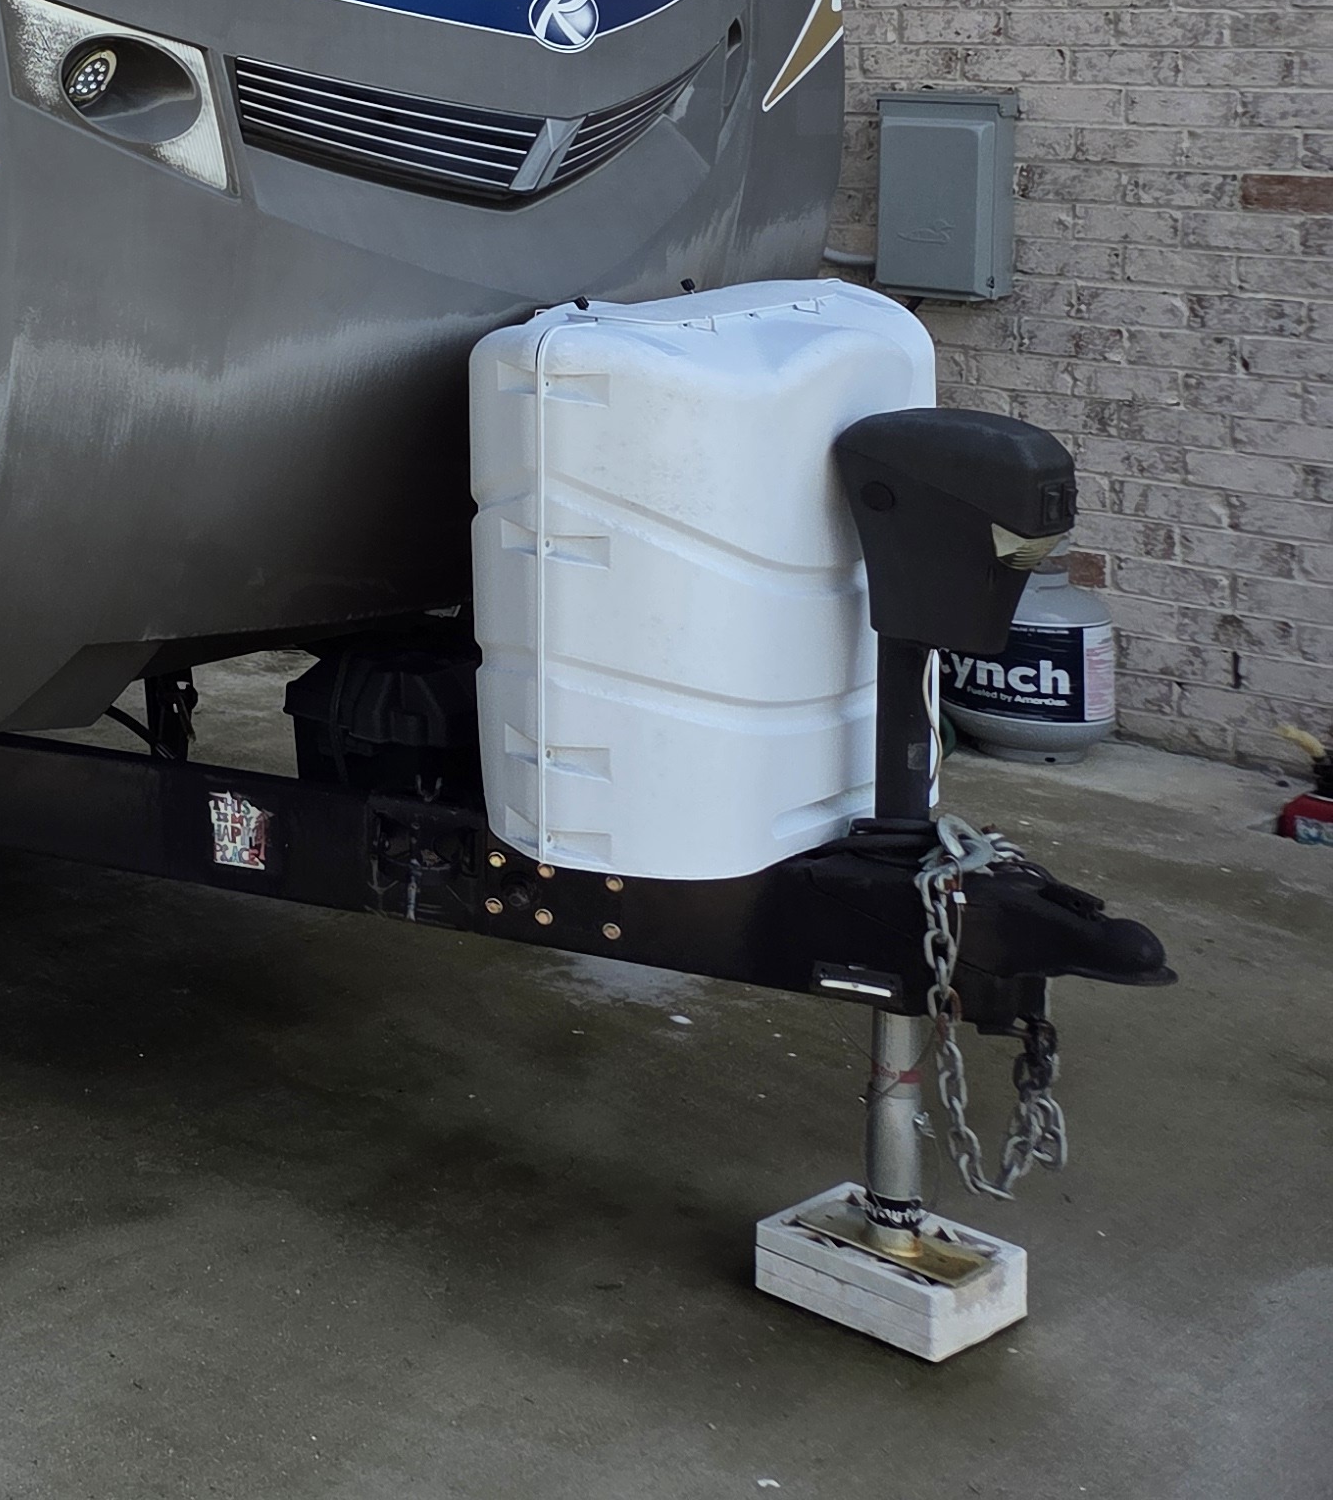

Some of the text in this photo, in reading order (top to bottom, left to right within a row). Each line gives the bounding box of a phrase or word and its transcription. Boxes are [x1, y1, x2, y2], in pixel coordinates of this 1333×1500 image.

[213, 797, 251, 815] THIS
[231, 813, 254, 827] MY
[214, 843, 260, 866] PLACE
